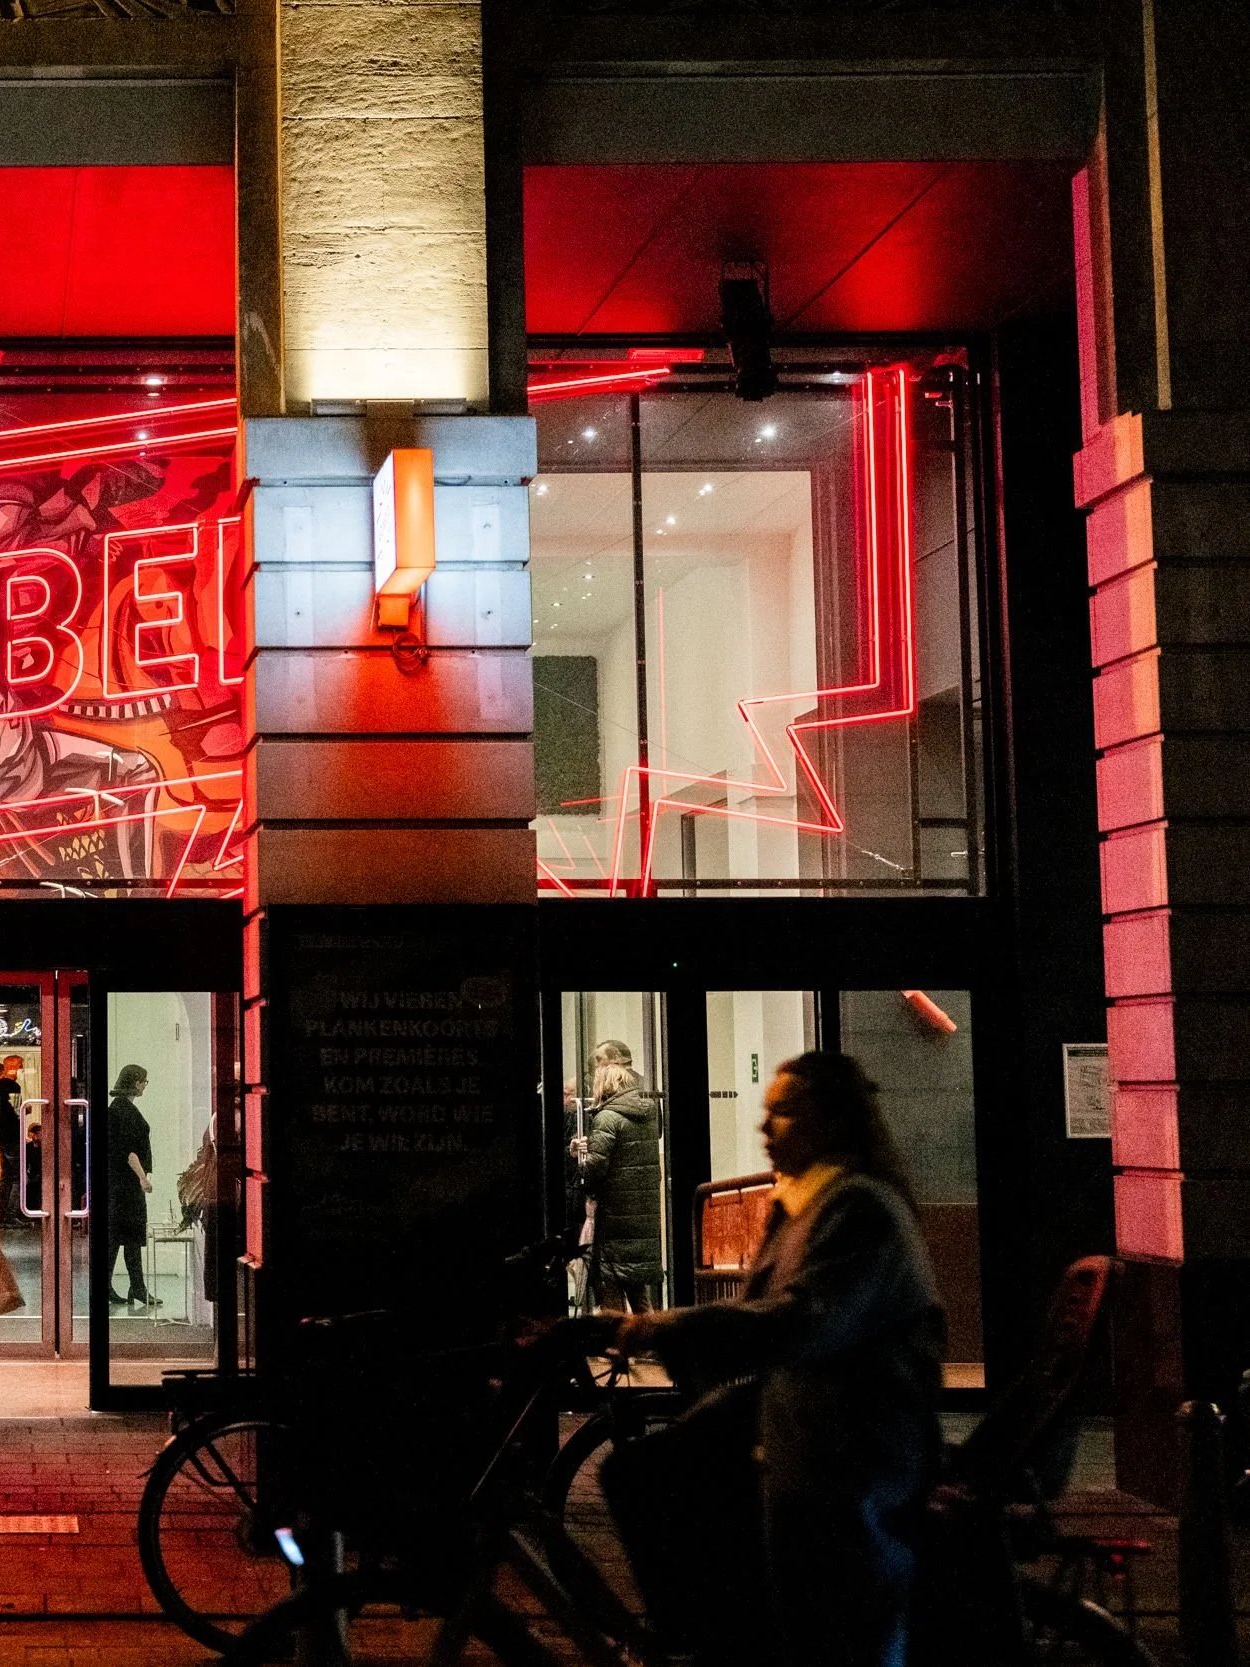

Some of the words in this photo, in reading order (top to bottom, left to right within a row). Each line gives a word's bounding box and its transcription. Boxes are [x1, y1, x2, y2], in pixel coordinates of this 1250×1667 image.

[319, 1047, 349, 1067] EN
[323, 1076, 375, 1095] KOM
[455, 1076, 481, 1095] JE
[340, 1132, 365, 1152] JE
